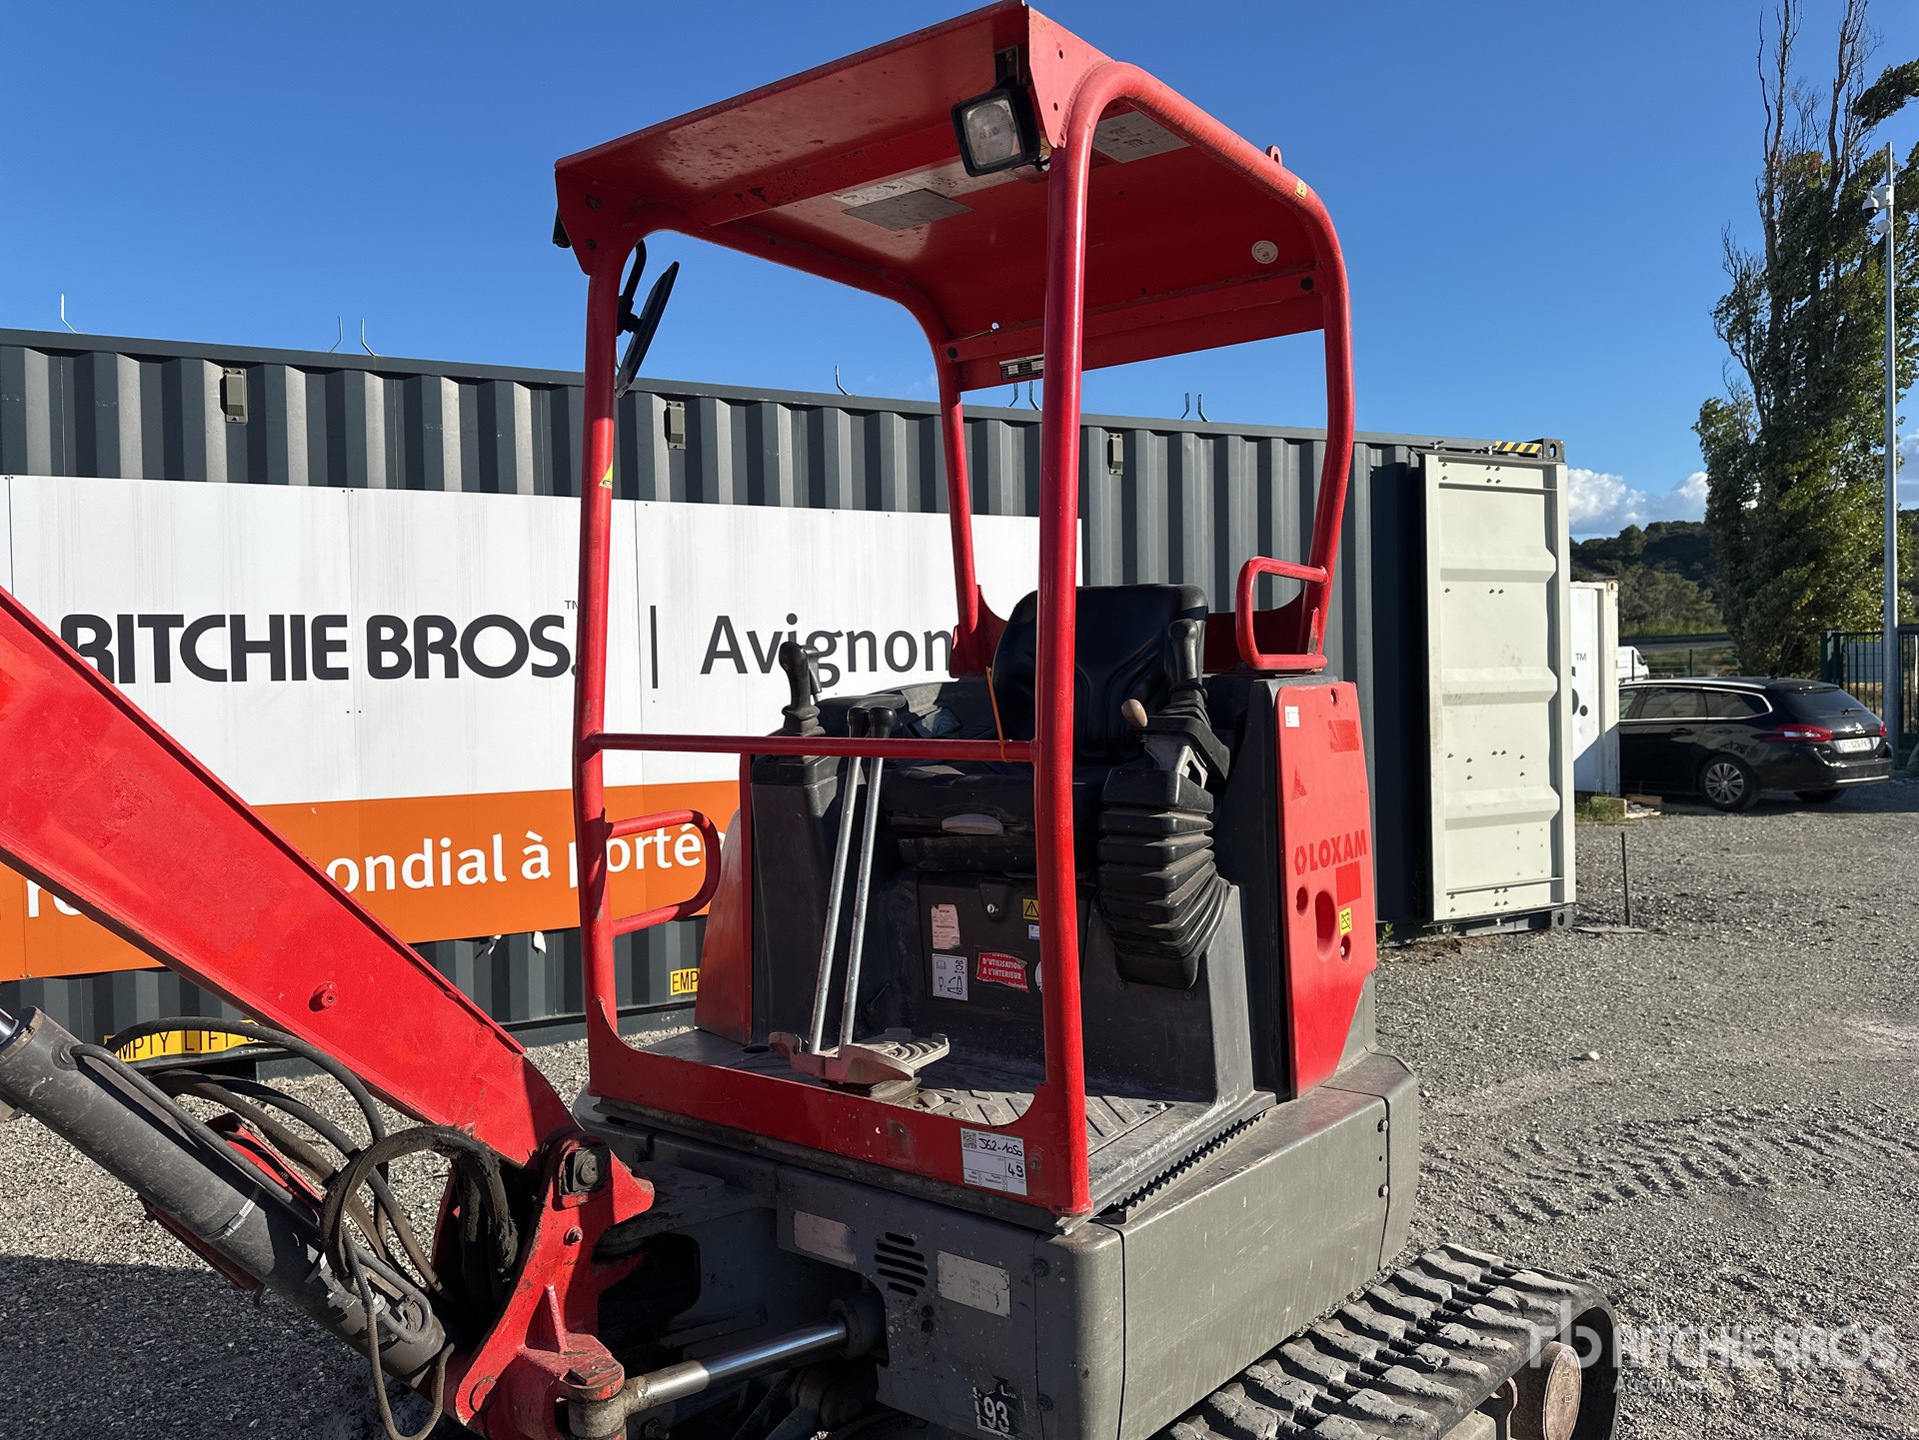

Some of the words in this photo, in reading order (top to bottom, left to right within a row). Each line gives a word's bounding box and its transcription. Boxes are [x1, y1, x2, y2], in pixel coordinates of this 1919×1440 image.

[60, 613, 349, 684] RITCHIE
[1575, 652, 1587, 661] TM
[325, 832, 508, 894] ondial
[521, 829, 551, 880] à
[569, 823, 726, 889] orté
[672, 970, 700, 993] EMP
[107, 1030, 170, 1060] MPTY
[1007, 1163, 1024, 1178] 49
[983, 1396, 1010, 1434] 93
